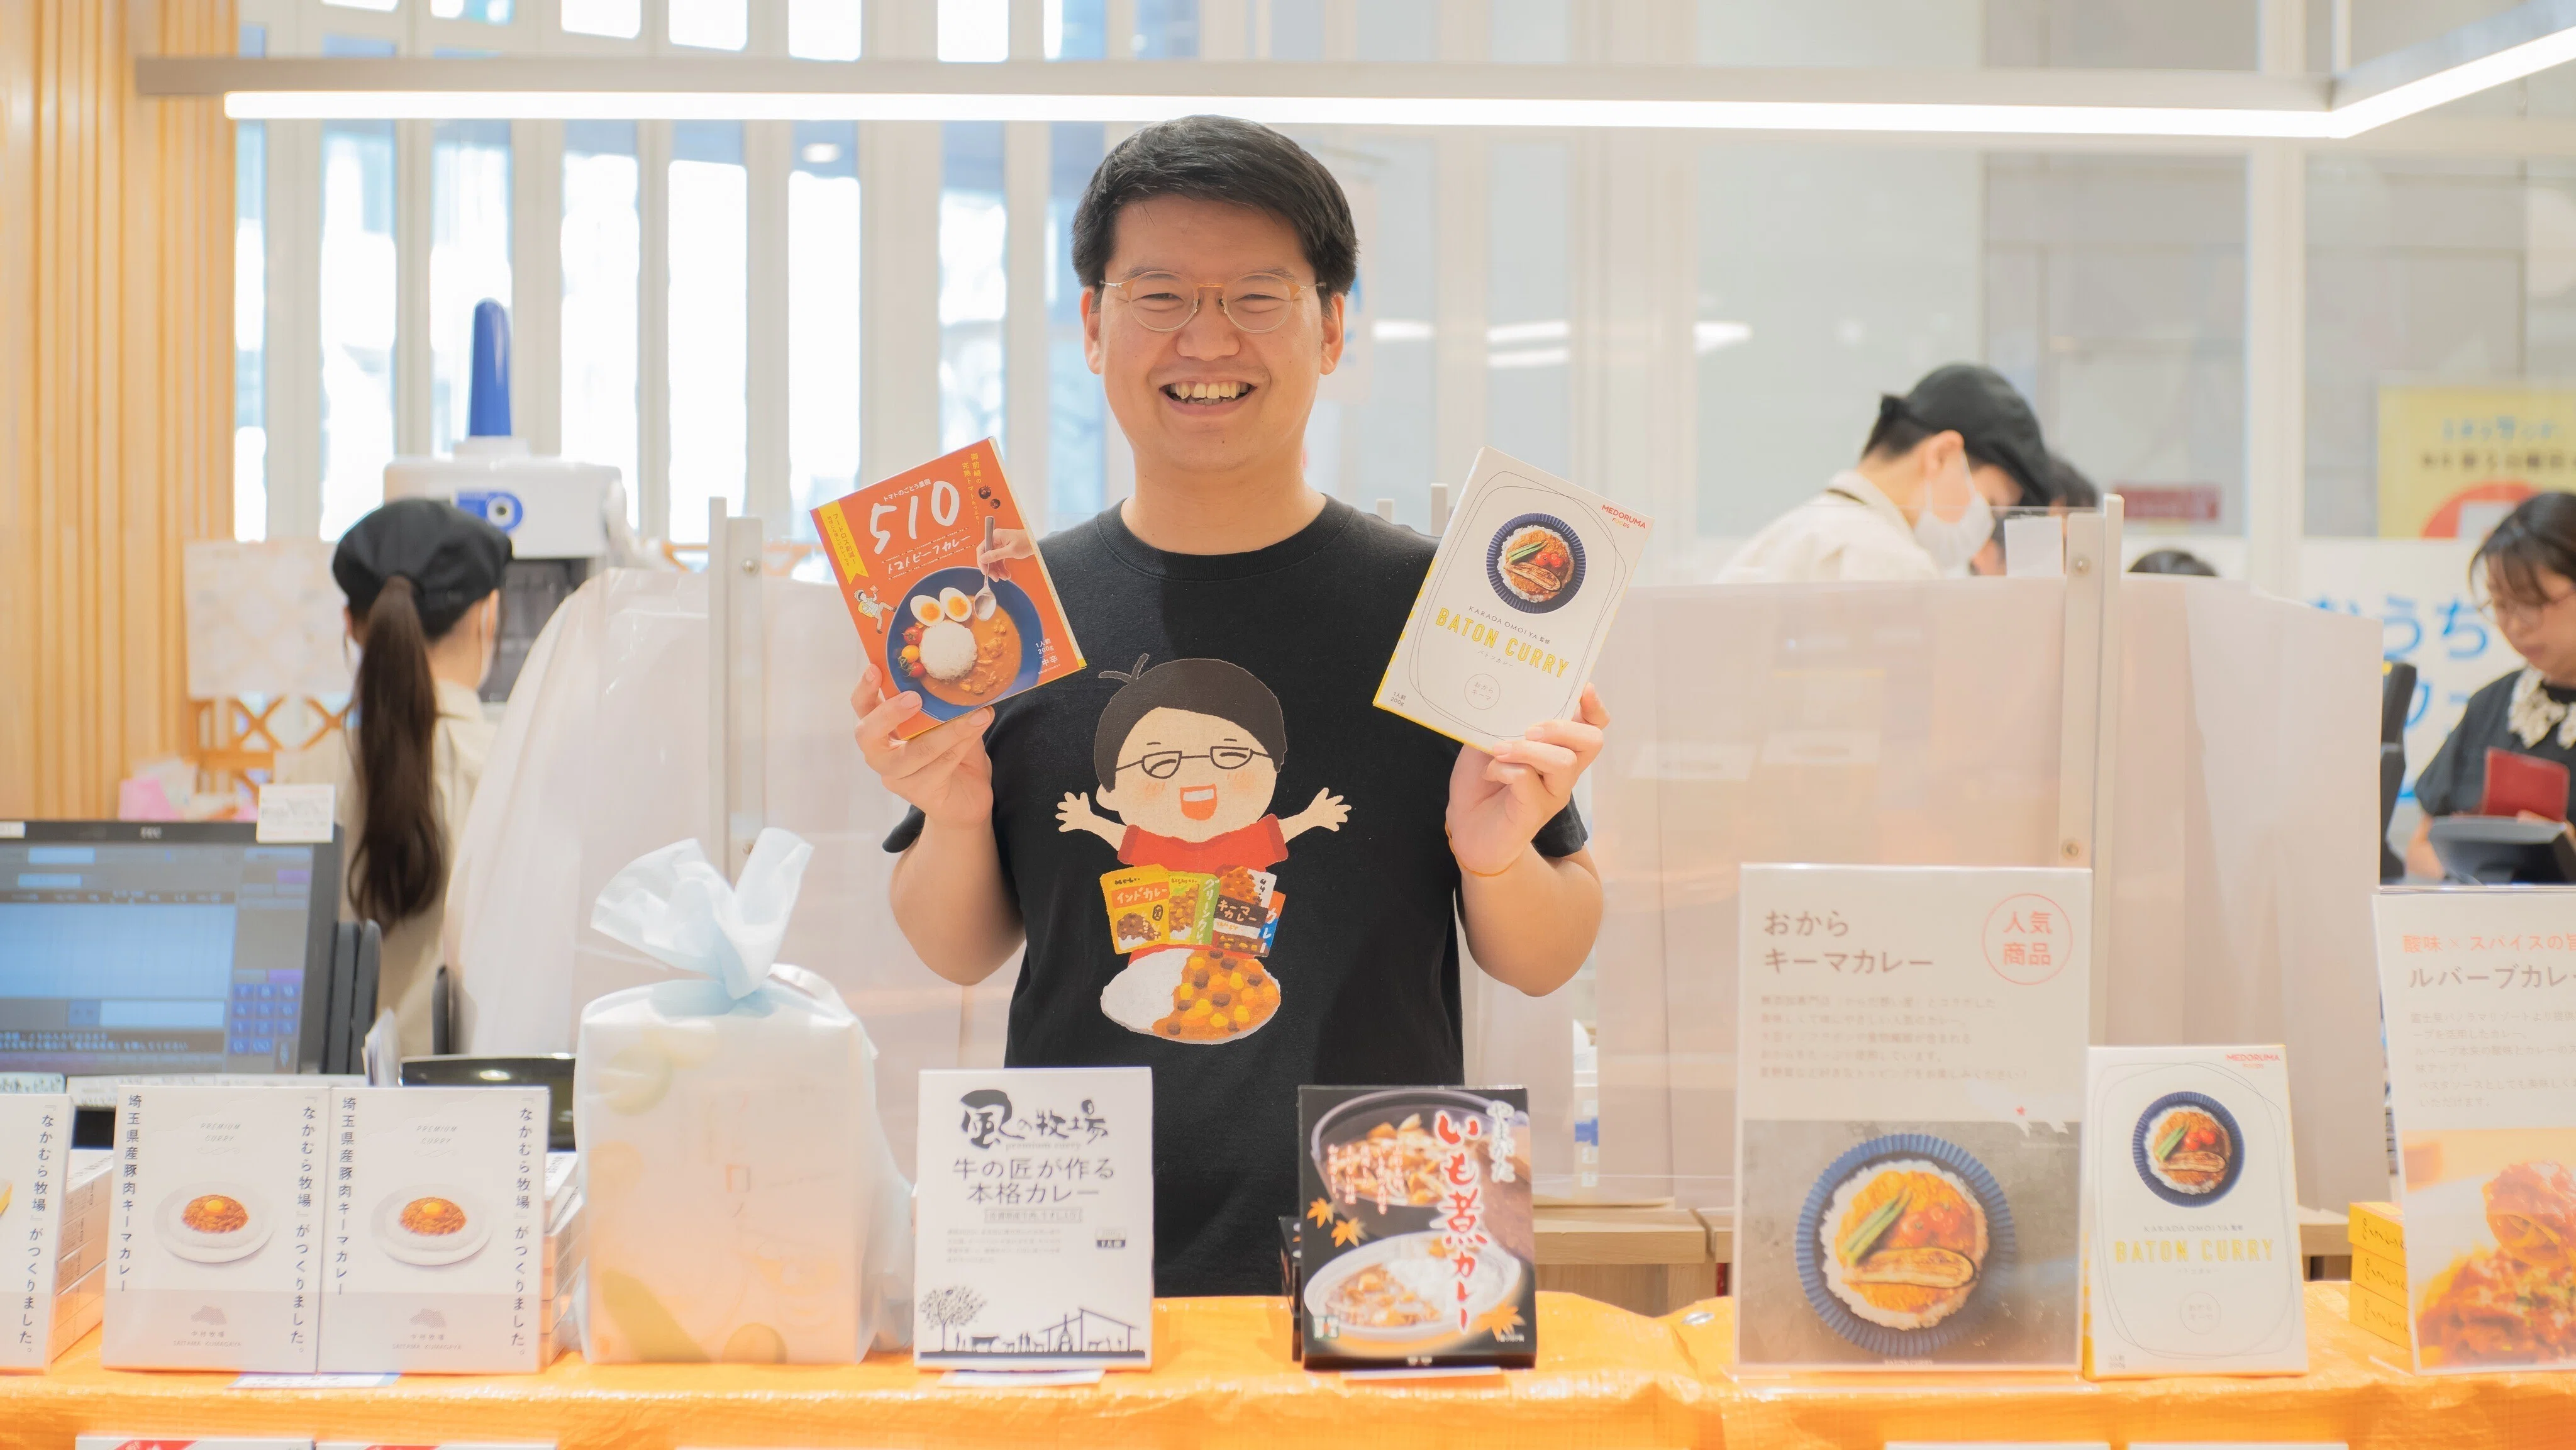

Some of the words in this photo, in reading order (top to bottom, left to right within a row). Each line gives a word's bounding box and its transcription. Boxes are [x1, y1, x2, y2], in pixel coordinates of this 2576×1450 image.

[970, 453, 982, 483] 御前崎の
[883, 478, 931, 502] トマトのごとう農園
[870, 481, 960, 555] 510
[1601, 504, 1646, 529] MEDORUMA
[1612, 517, 1630, 529] FOODS
[888, 535, 971, 574] トマトビーフカレー
[1468, 605, 1502, 625] KARADA
[2309, 594, 2489, 659] うち
[1035, 638, 1051, 648] 1人前
[1038, 645, 1054, 654] 200g
[1435, 607, 1499, 649] BATON
[1505, 638, 1570, 678] CURRY
[1041, 655, 1058, 666] 中辛
[1478, 649, 1514, 667] バトンカレー
[1392, 691, 1407, 701] 1人前
[1470, 688, 1493, 702] キーマ
[1474, 681, 1494, 694] おから
[1390, 696, 1404, 707] 200g
[1116, 886, 1169, 905] インドカレー
[1218, 900, 1250, 915] キーマ
[1224, 909, 1257, 922] カレー
[1764, 910, 1849, 937] おから
[2003, 911, 2053, 935] 人気
[1259, 907, 1277, 954] カレー
[2003, 942, 2051, 967] 商品
[2402, 934, 2443, 953] 酸味
[1764, 949, 1933, 974] キーマカレー
[2409, 964, 2576, 990] ルバーブカレ
[2411, 1011, 2576, 1024] 富士見パノラマリゾートより提供
[2226, 1054, 2280, 1062] MEDORUMA
[2419, 1078, 2576, 1091] パスタソースとしても美味しく
[960, 1089, 1109, 1150] 風の牧場
[953, 1157, 1114, 1180] 牛の匠が作る
[118, 1095, 142, 1292] 埼玉県産豚肉キーマカレー
[335, 1096, 357, 1296] 埼玉県産豚肉キーマカレー
[967, 1183, 1099, 1205] 本格カレー
[19, 1104, 57, 1353] 『なかむら牧場』がつくりました。
[291, 1096, 318, 1353] 『なかむら牧場』がつくりました。
[511, 1098, 534, 1356] 『なかむら牧場』がつくりました。
[1435, 1112, 1489, 1332] いも煮カレー
[2114, 1240, 2189, 1263] BATON
[2201, 1239, 2274, 1262] CURRY
